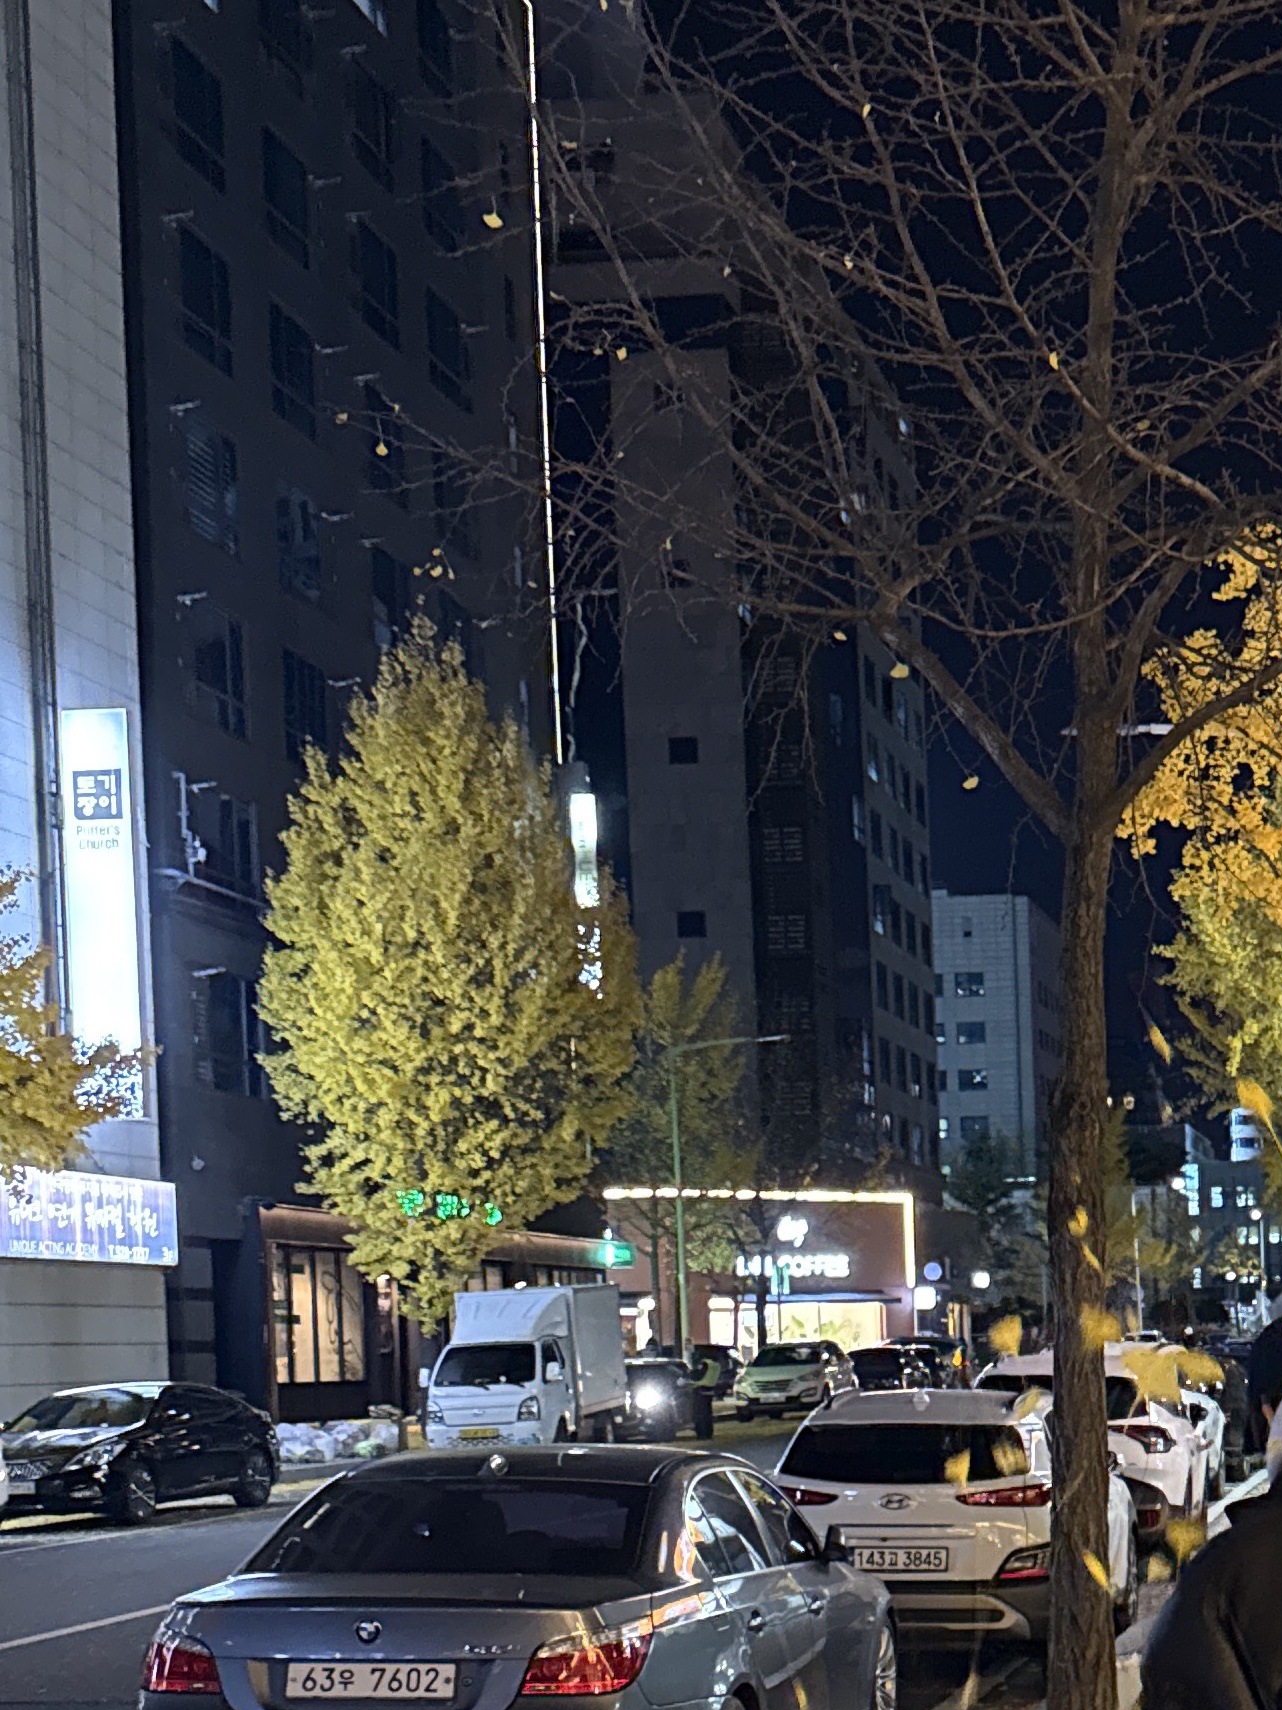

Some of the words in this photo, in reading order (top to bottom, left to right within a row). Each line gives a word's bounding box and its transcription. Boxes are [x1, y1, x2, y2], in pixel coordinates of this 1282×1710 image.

[77, 774, 117, 795] 토기
[9, 1239, 38, 1254] UNIQUE
[38, 1241, 65, 1255] ACTING
[903, 1550, 943, 1568] 3845
[302, 1666, 355, 1693] 63우
[370, 1666, 440, 1693] 7602
